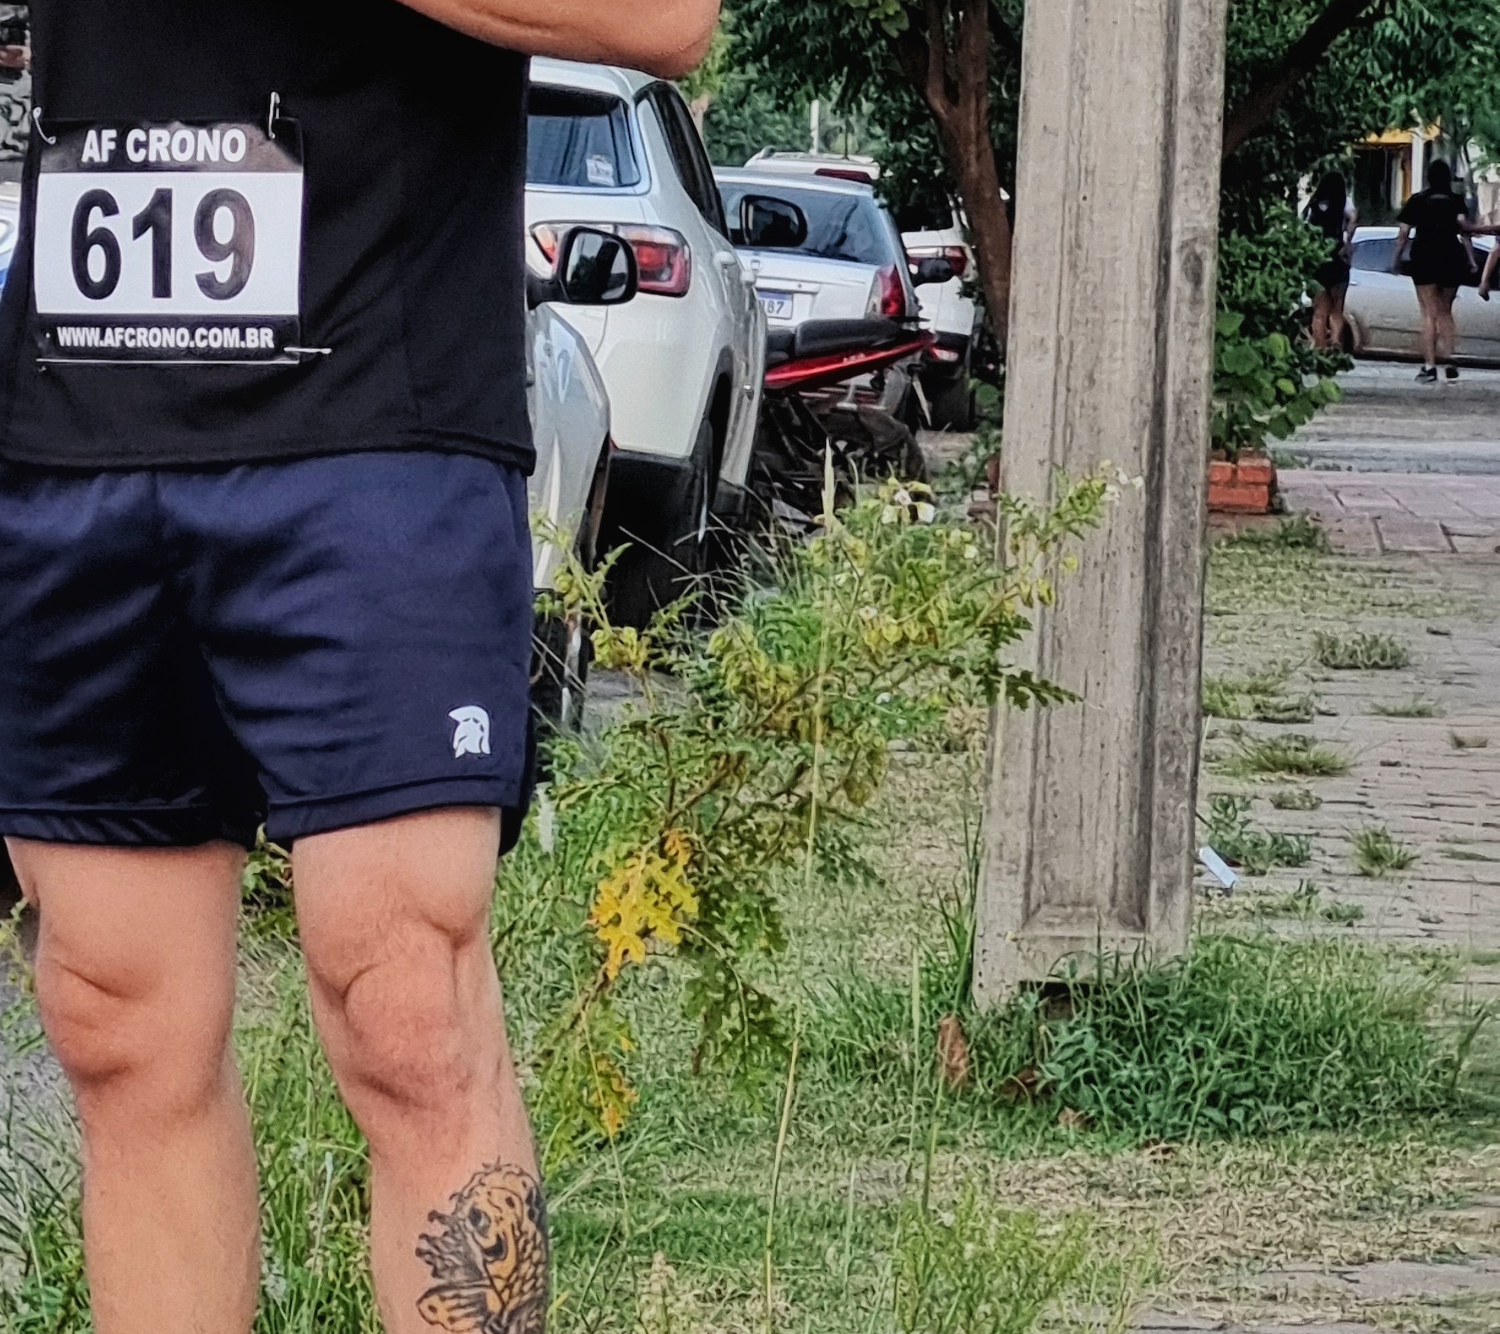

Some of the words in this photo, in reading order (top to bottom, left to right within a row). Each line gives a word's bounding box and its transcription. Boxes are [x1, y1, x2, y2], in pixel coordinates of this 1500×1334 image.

[80, 128, 118, 163] AF
[125, 127, 247, 163] CRONO
[70, 187, 256, 301] 619
[56, 325, 275, 349] WWW.AFCRONO.COM.BR
